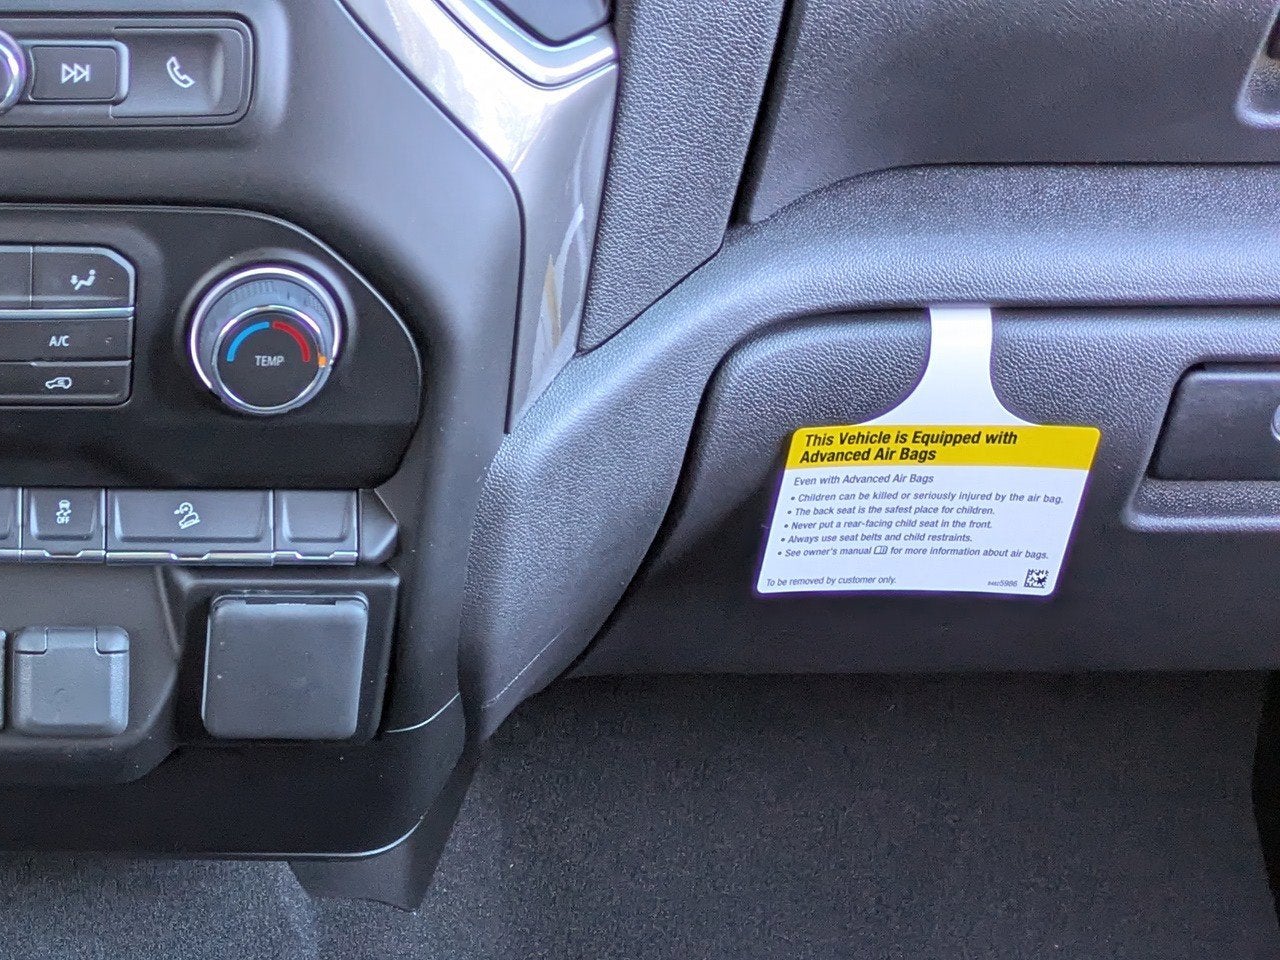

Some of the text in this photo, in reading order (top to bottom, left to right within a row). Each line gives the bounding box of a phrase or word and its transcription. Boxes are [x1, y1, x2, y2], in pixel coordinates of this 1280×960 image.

[49, 335, 70, 346] A/C
[255, 355, 285, 366] TEMP
[806, 430, 1018, 447] This Vehicle is Equipped with
[800, 448, 936, 464] Advanced Air Bags
[794, 474, 934, 486] Even with Advanced Air Bags
[798, 493, 836, 502] Children
[859, 492, 870, 500] be
[872, 492, 898, 500] killed
[913, 492, 956, 501] seriously
[959, 492, 992, 501] injured
[995, 492, 1006, 502] by
[1010, 492, 1025, 502] the
[1028, 494, 1040, 502] air
[1043, 495, 1064, 505] bag.
[795, 506, 995, 516] The back seat is the safest place for children.
[56, 516, 70, 524] OFF
[791, 522, 817, 530] Never
[819, 520, 834, 530] put
[844, 520, 892, 528] rear-facing
[895, 519, 917, 528] child
[919, 520, 938, 528] seat
[941, 520, 949, 528] in
[952, 520, 966, 528] the
[788, 535, 819, 544] Always
[839, 534, 858, 542] seat
[860, 533, 882, 542] belts
[884, 533, 902, 541] and
[904, 533, 926, 542] child
[928, 534, 972, 542] restraints.
[785, 549, 801, 557] See
[804, 548, 837, 556] owner's
[840, 547, 871, 555] manual
[930, 547, 980, 556] information
[983, 548, 1008, 557] about
[1010, 550, 1022, 558] air
[1025, 550, 1049, 560] bags.
[766, 576, 896, 586] To be removed by customer only.
